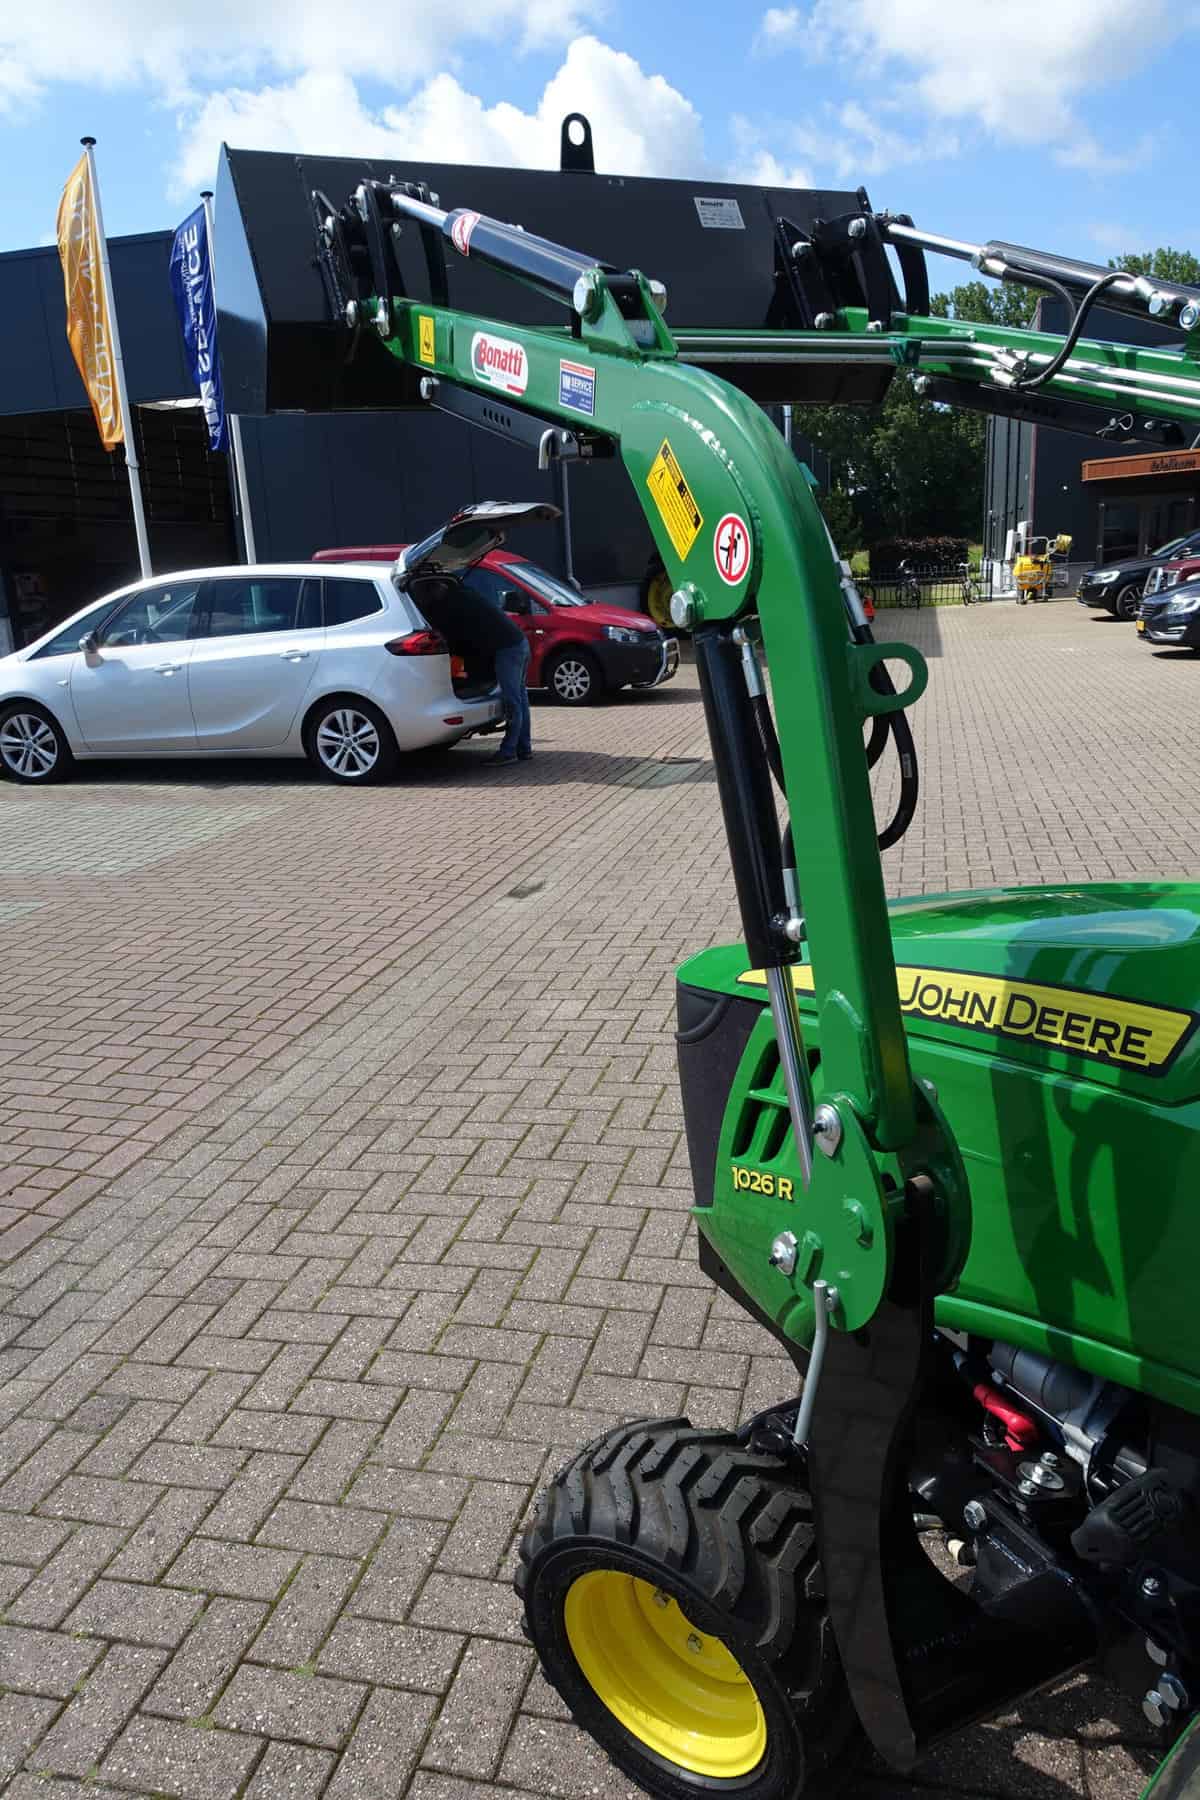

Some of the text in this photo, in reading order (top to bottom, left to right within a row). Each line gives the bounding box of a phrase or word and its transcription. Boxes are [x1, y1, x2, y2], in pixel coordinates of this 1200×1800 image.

[478, 338, 524, 377] Bonatti
[898, 975, 1153, 1061] JOHN DEERE
[731, 1165, 794, 1201] 1026 R
